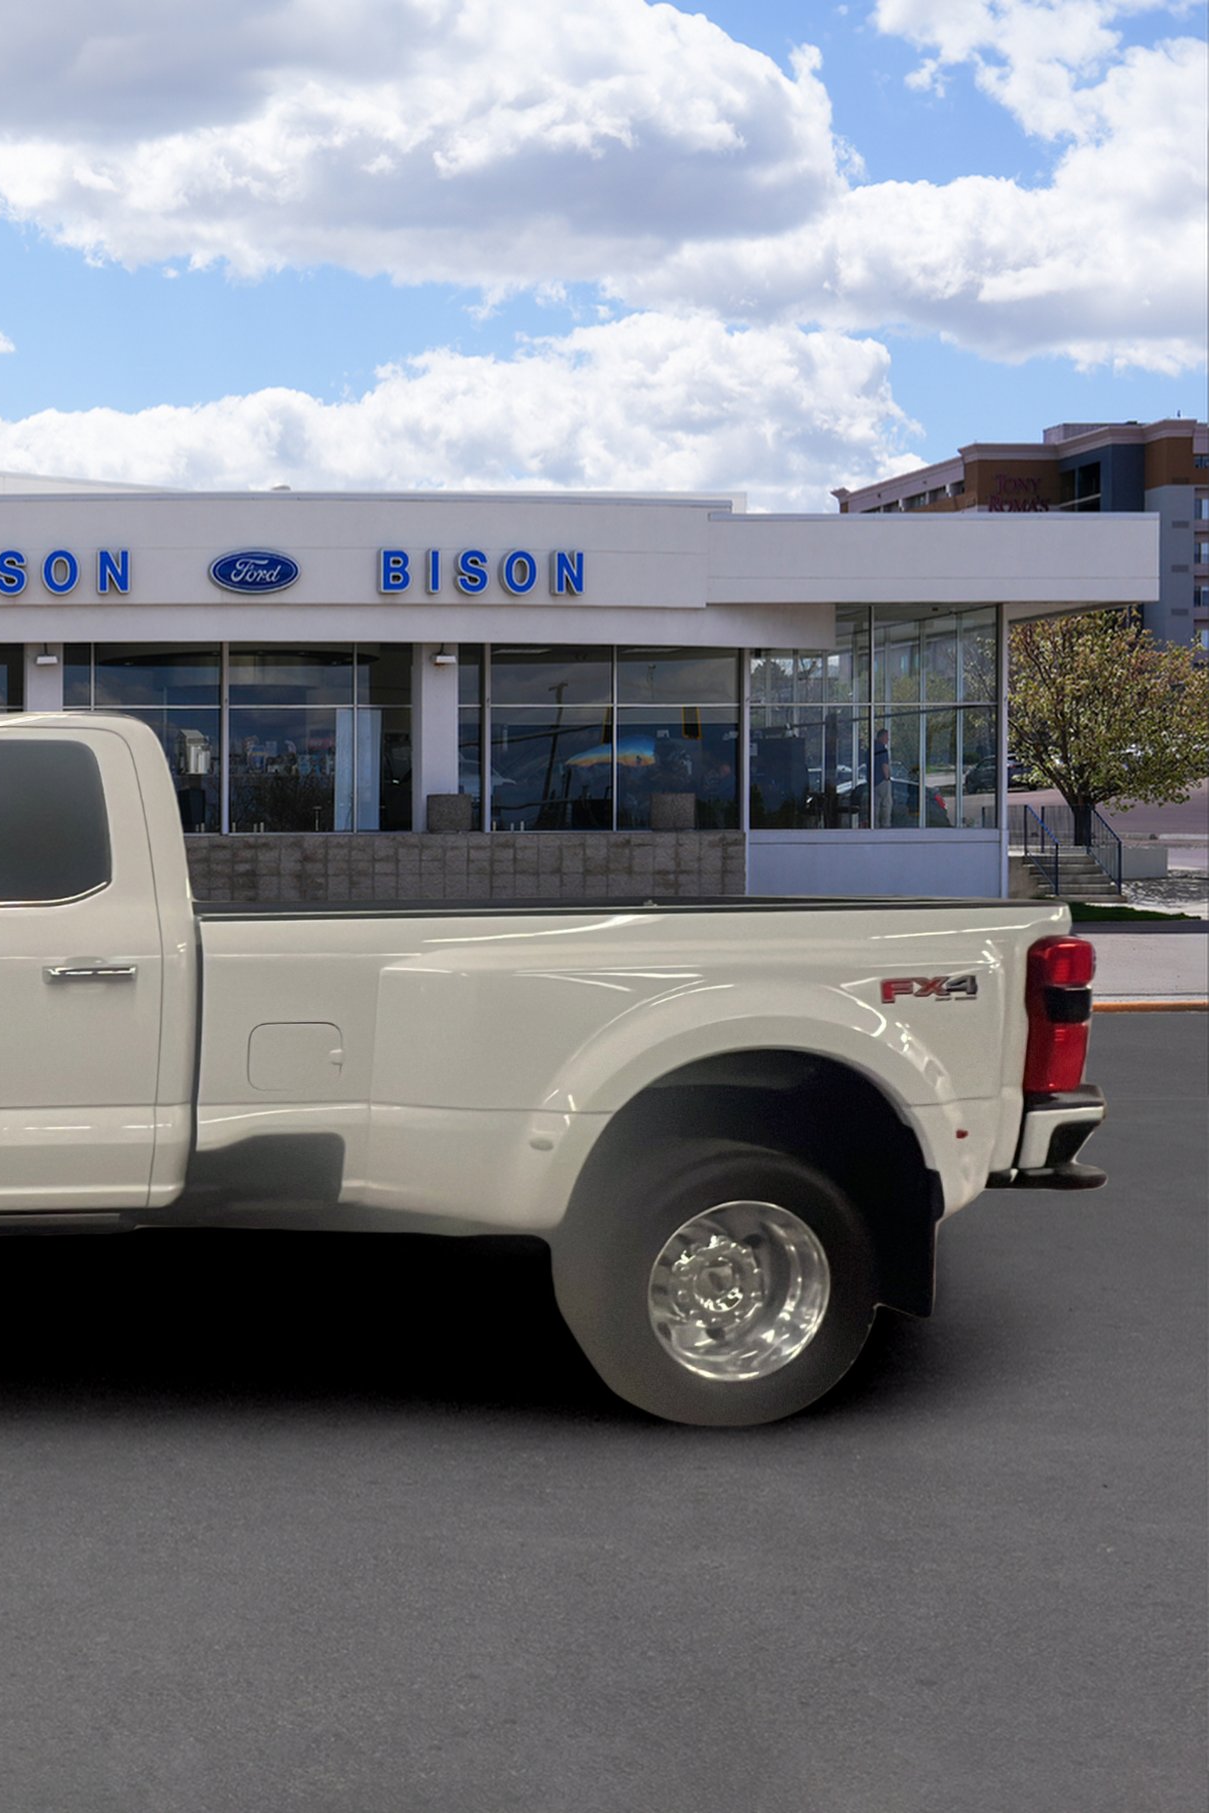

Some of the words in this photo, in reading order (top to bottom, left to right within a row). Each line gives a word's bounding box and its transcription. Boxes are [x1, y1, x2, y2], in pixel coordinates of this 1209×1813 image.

[230, 558, 282, 582] Ford
[378, 549, 586, 596] BISON
[880, 975, 978, 1004] FX4
